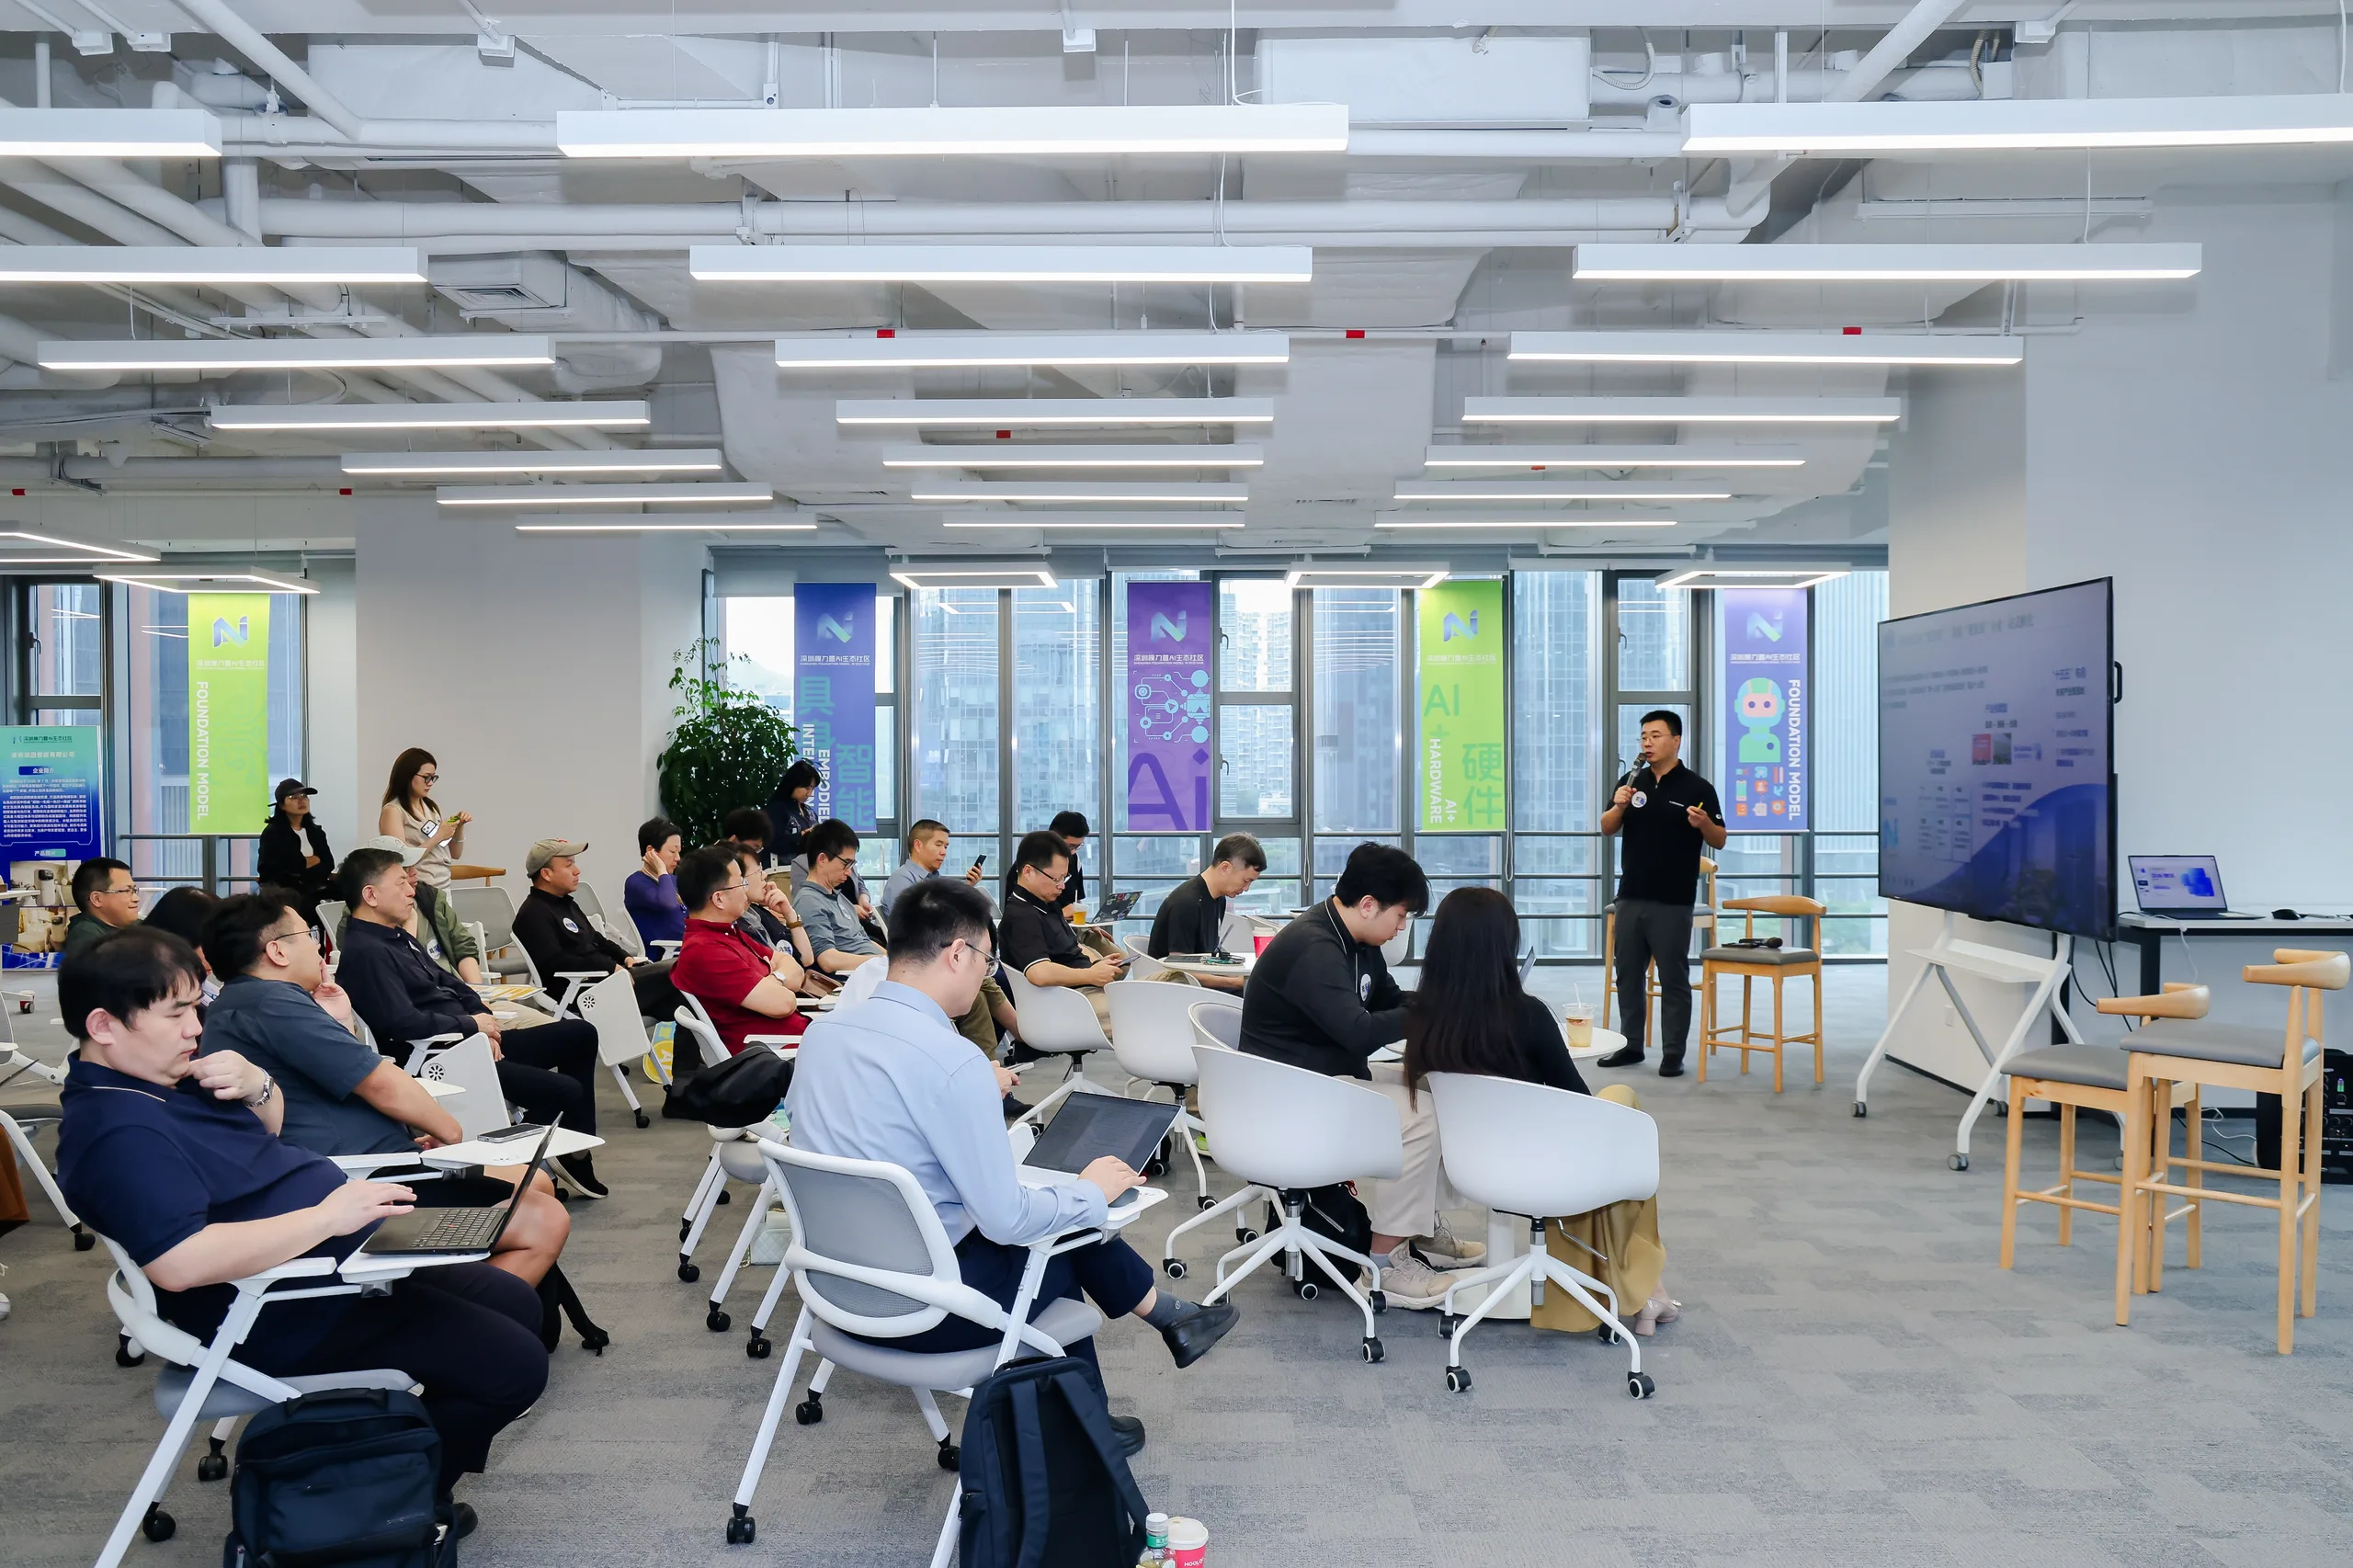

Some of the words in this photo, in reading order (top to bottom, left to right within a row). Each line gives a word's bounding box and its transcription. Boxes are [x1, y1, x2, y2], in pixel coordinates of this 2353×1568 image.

[196, 681, 210, 768] FOUNDATION
[1424, 684, 1461, 717] AI
[1788, 679, 1802, 767] FOUNDATION
[197, 772, 210, 821] MODEL
[1429, 738, 1442, 824] HARDWARE
[1461, 743, 1503, 825] 硬件
[1788, 772, 1802, 821] MODEL
